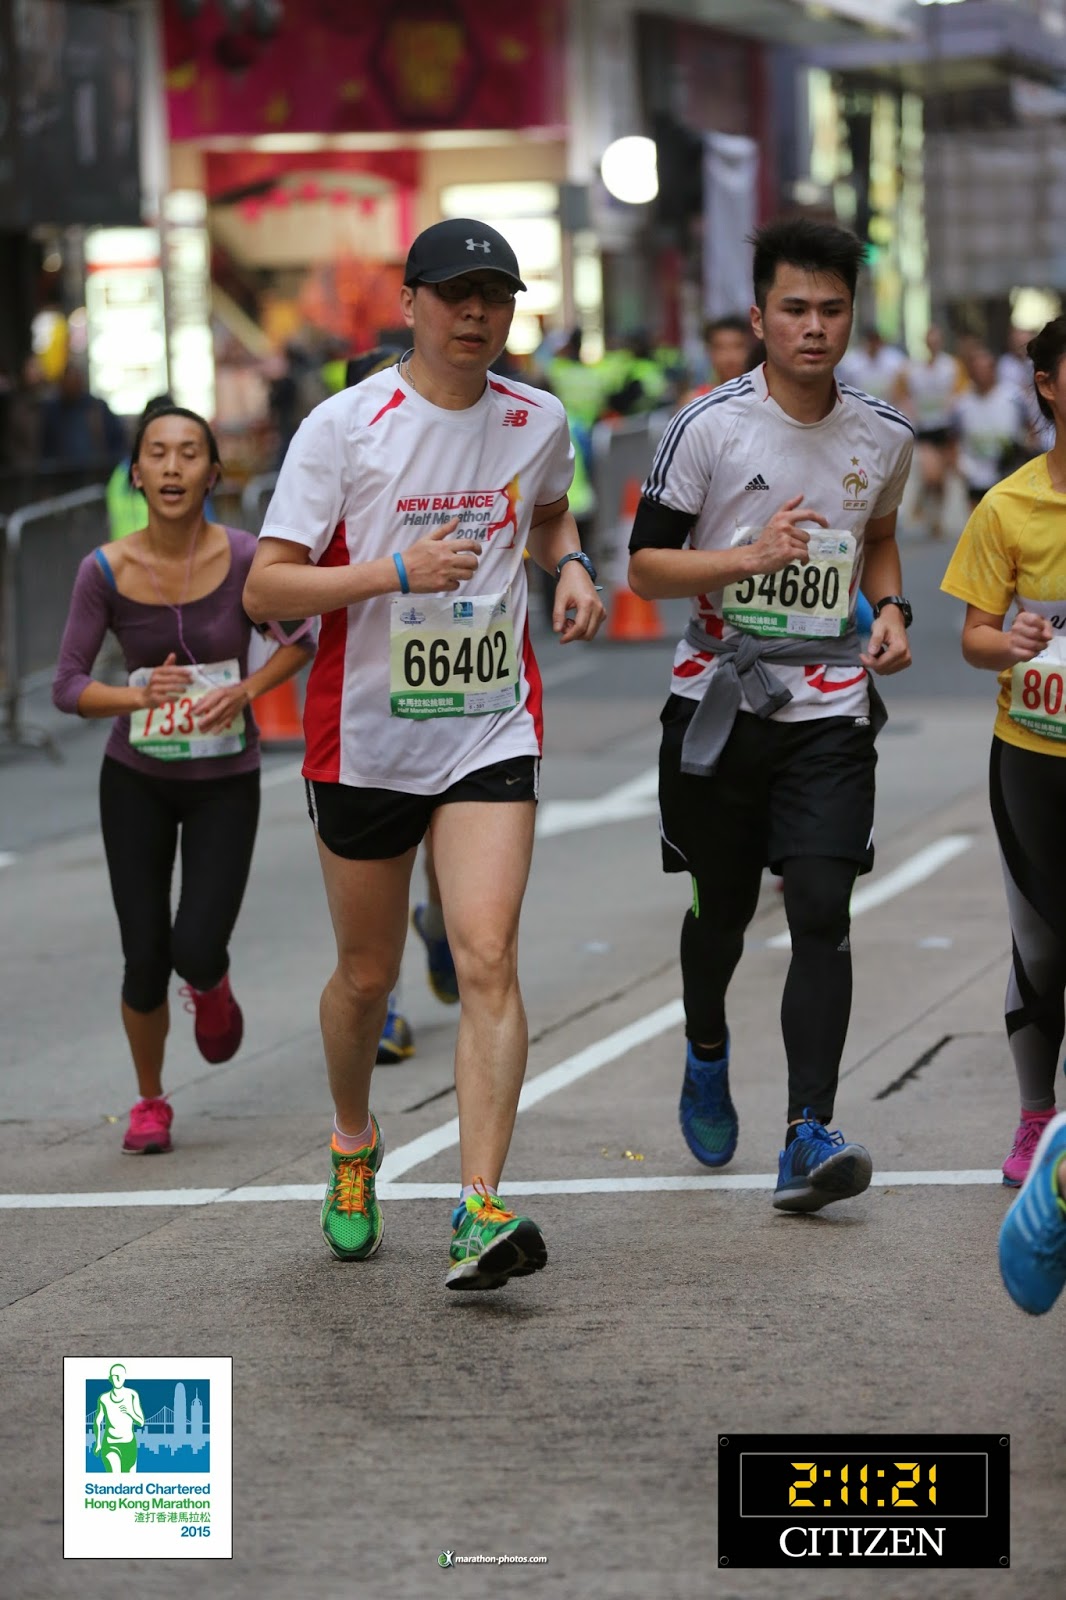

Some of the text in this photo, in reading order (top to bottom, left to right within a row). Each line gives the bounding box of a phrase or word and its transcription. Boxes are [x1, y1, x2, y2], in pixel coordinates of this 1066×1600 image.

[502, 409, 529, 427] NB
[396, 495, 494, 512] NEW BALANCE
[403, 510, 491, 526] Half Maathon
[456, 528, 486, 541] 2014
[735, 564, 840, 609] 54680
[404, 630, 510, 687] 66402
[1022, 669, 1066, 715] 80
